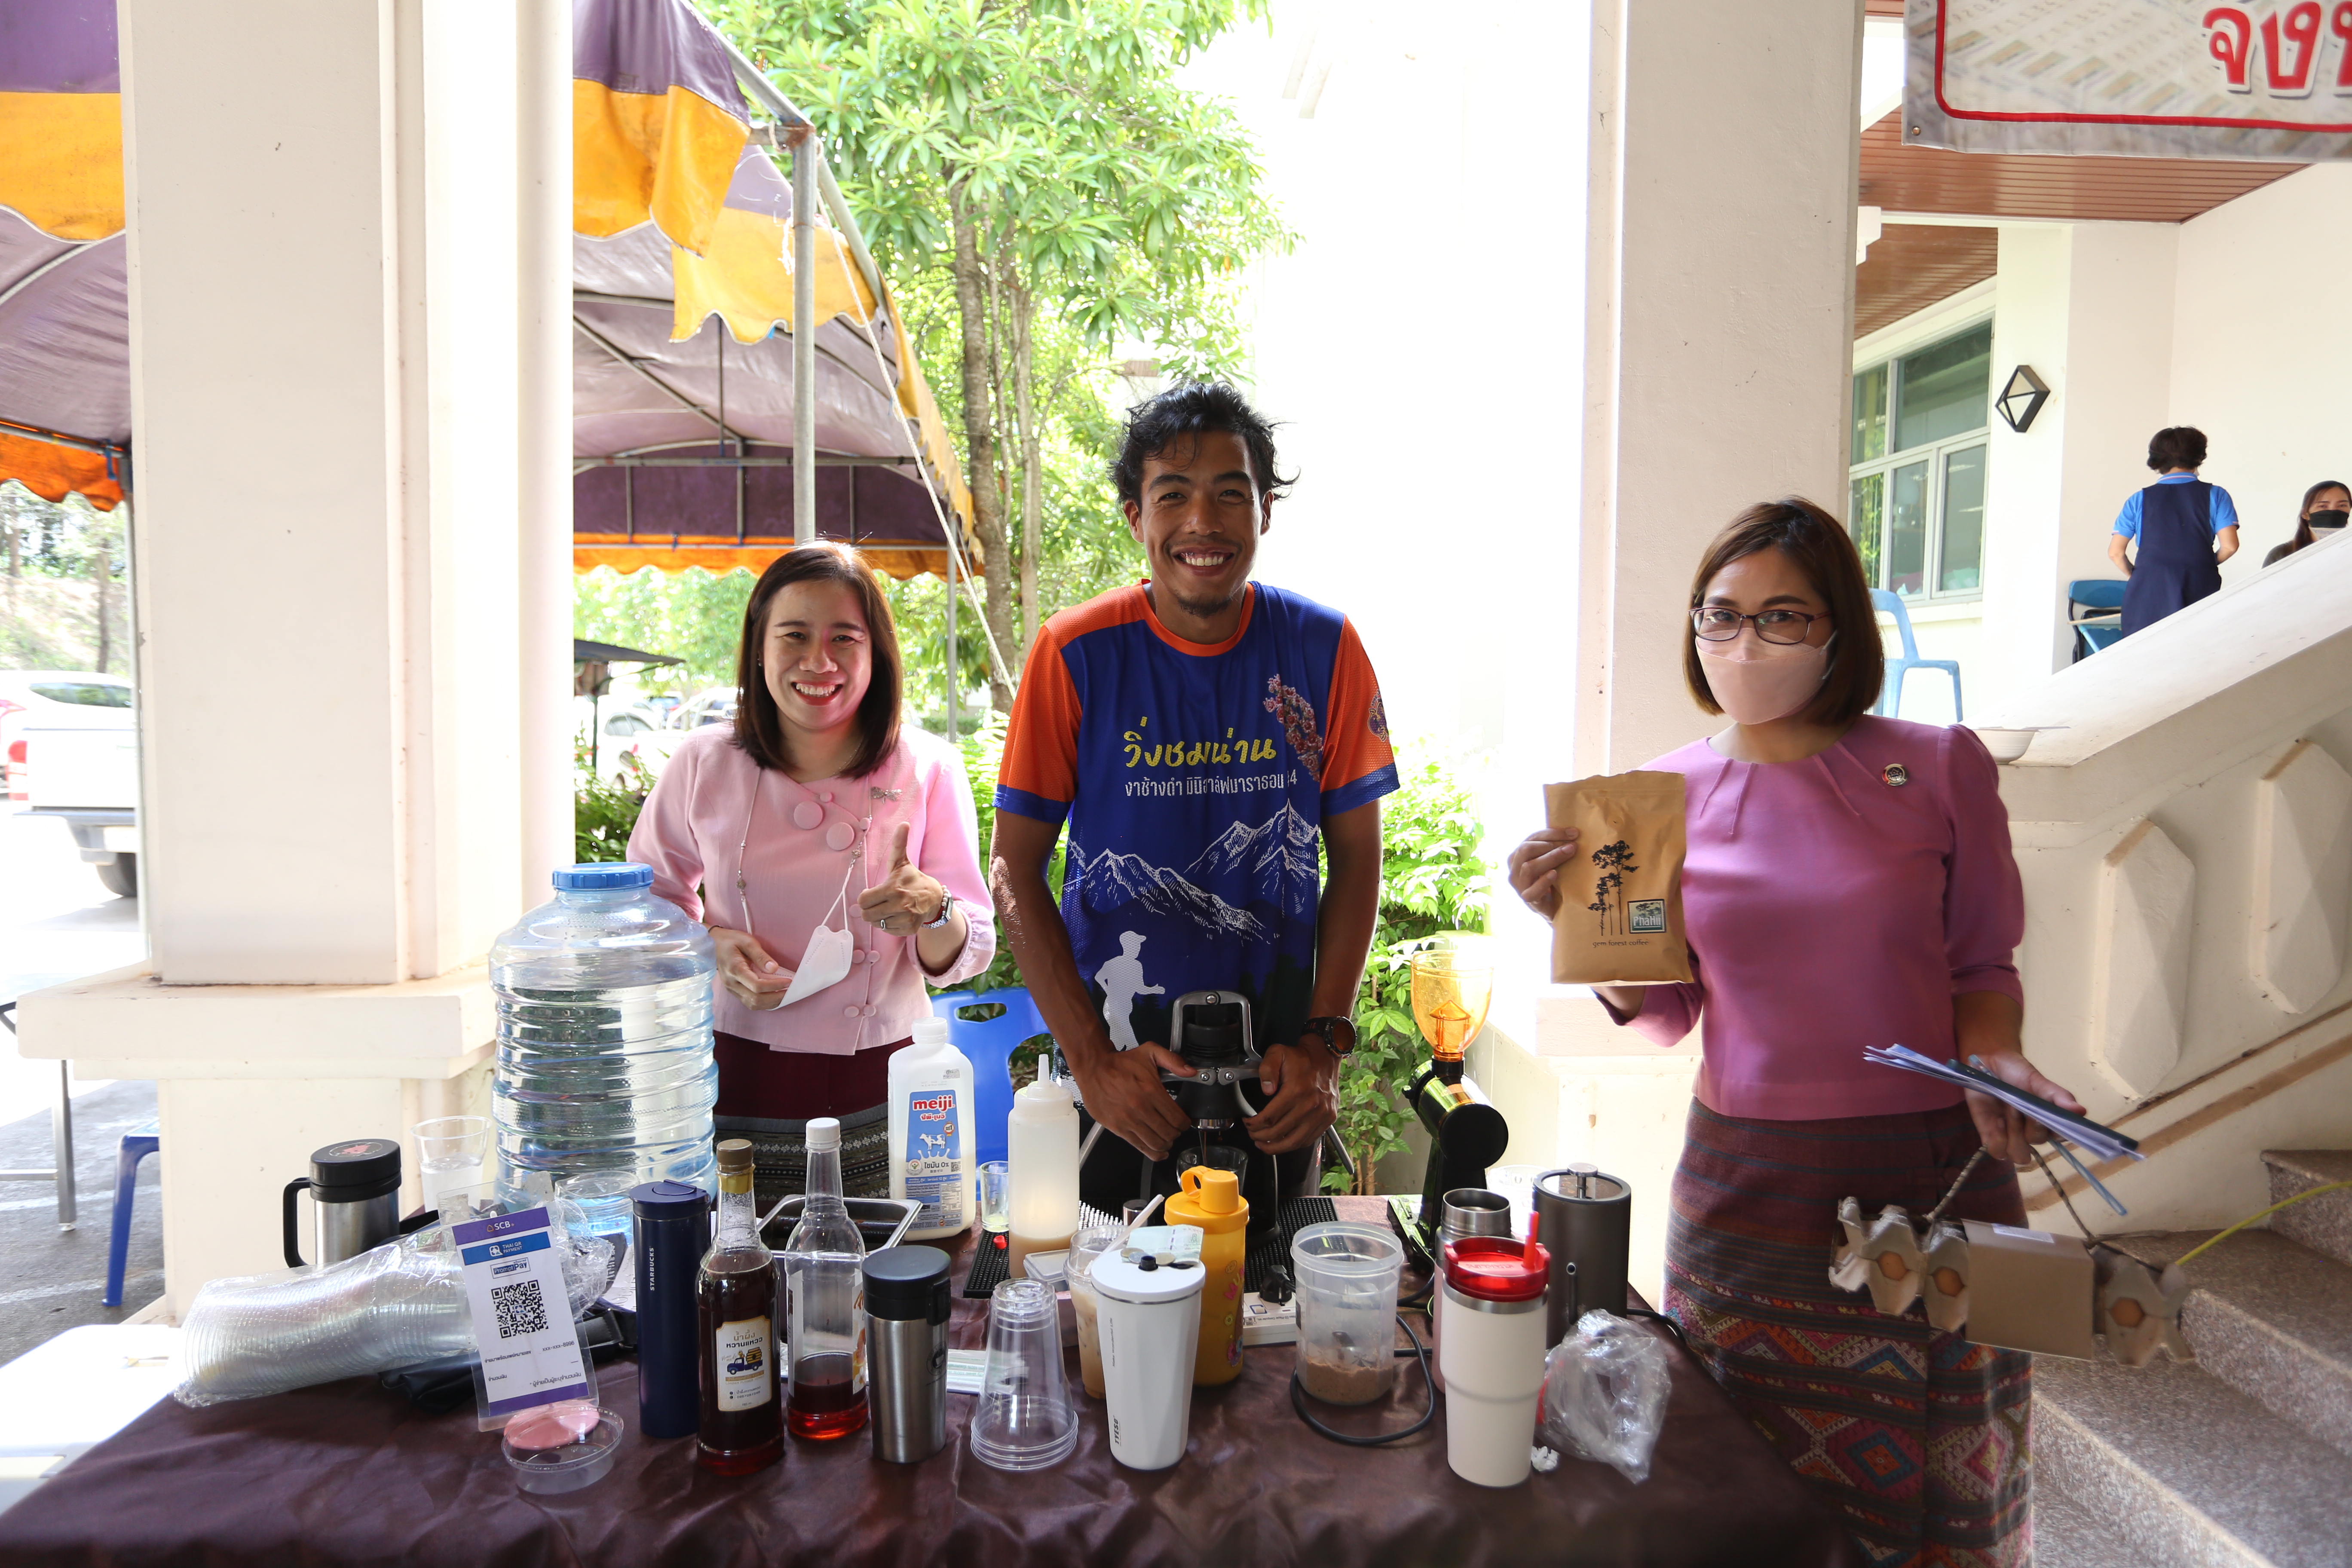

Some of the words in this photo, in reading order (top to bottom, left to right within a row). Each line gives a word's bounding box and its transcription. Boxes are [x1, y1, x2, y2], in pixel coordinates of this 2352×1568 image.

[1123, 716, 1277, 768] วิ่งชมน่าน
[1125, 777, 1182, 796] งาช้างดำ
[1287, 769, 1297, 787] 4
[914, 1096, 952, 1111] meiji
[494, 1221, 511, 1231] SCB
[734, 1329, 755, 1341] น้ำผึ้ง
[726, 1337, 763, 1348] หวานแหวว
